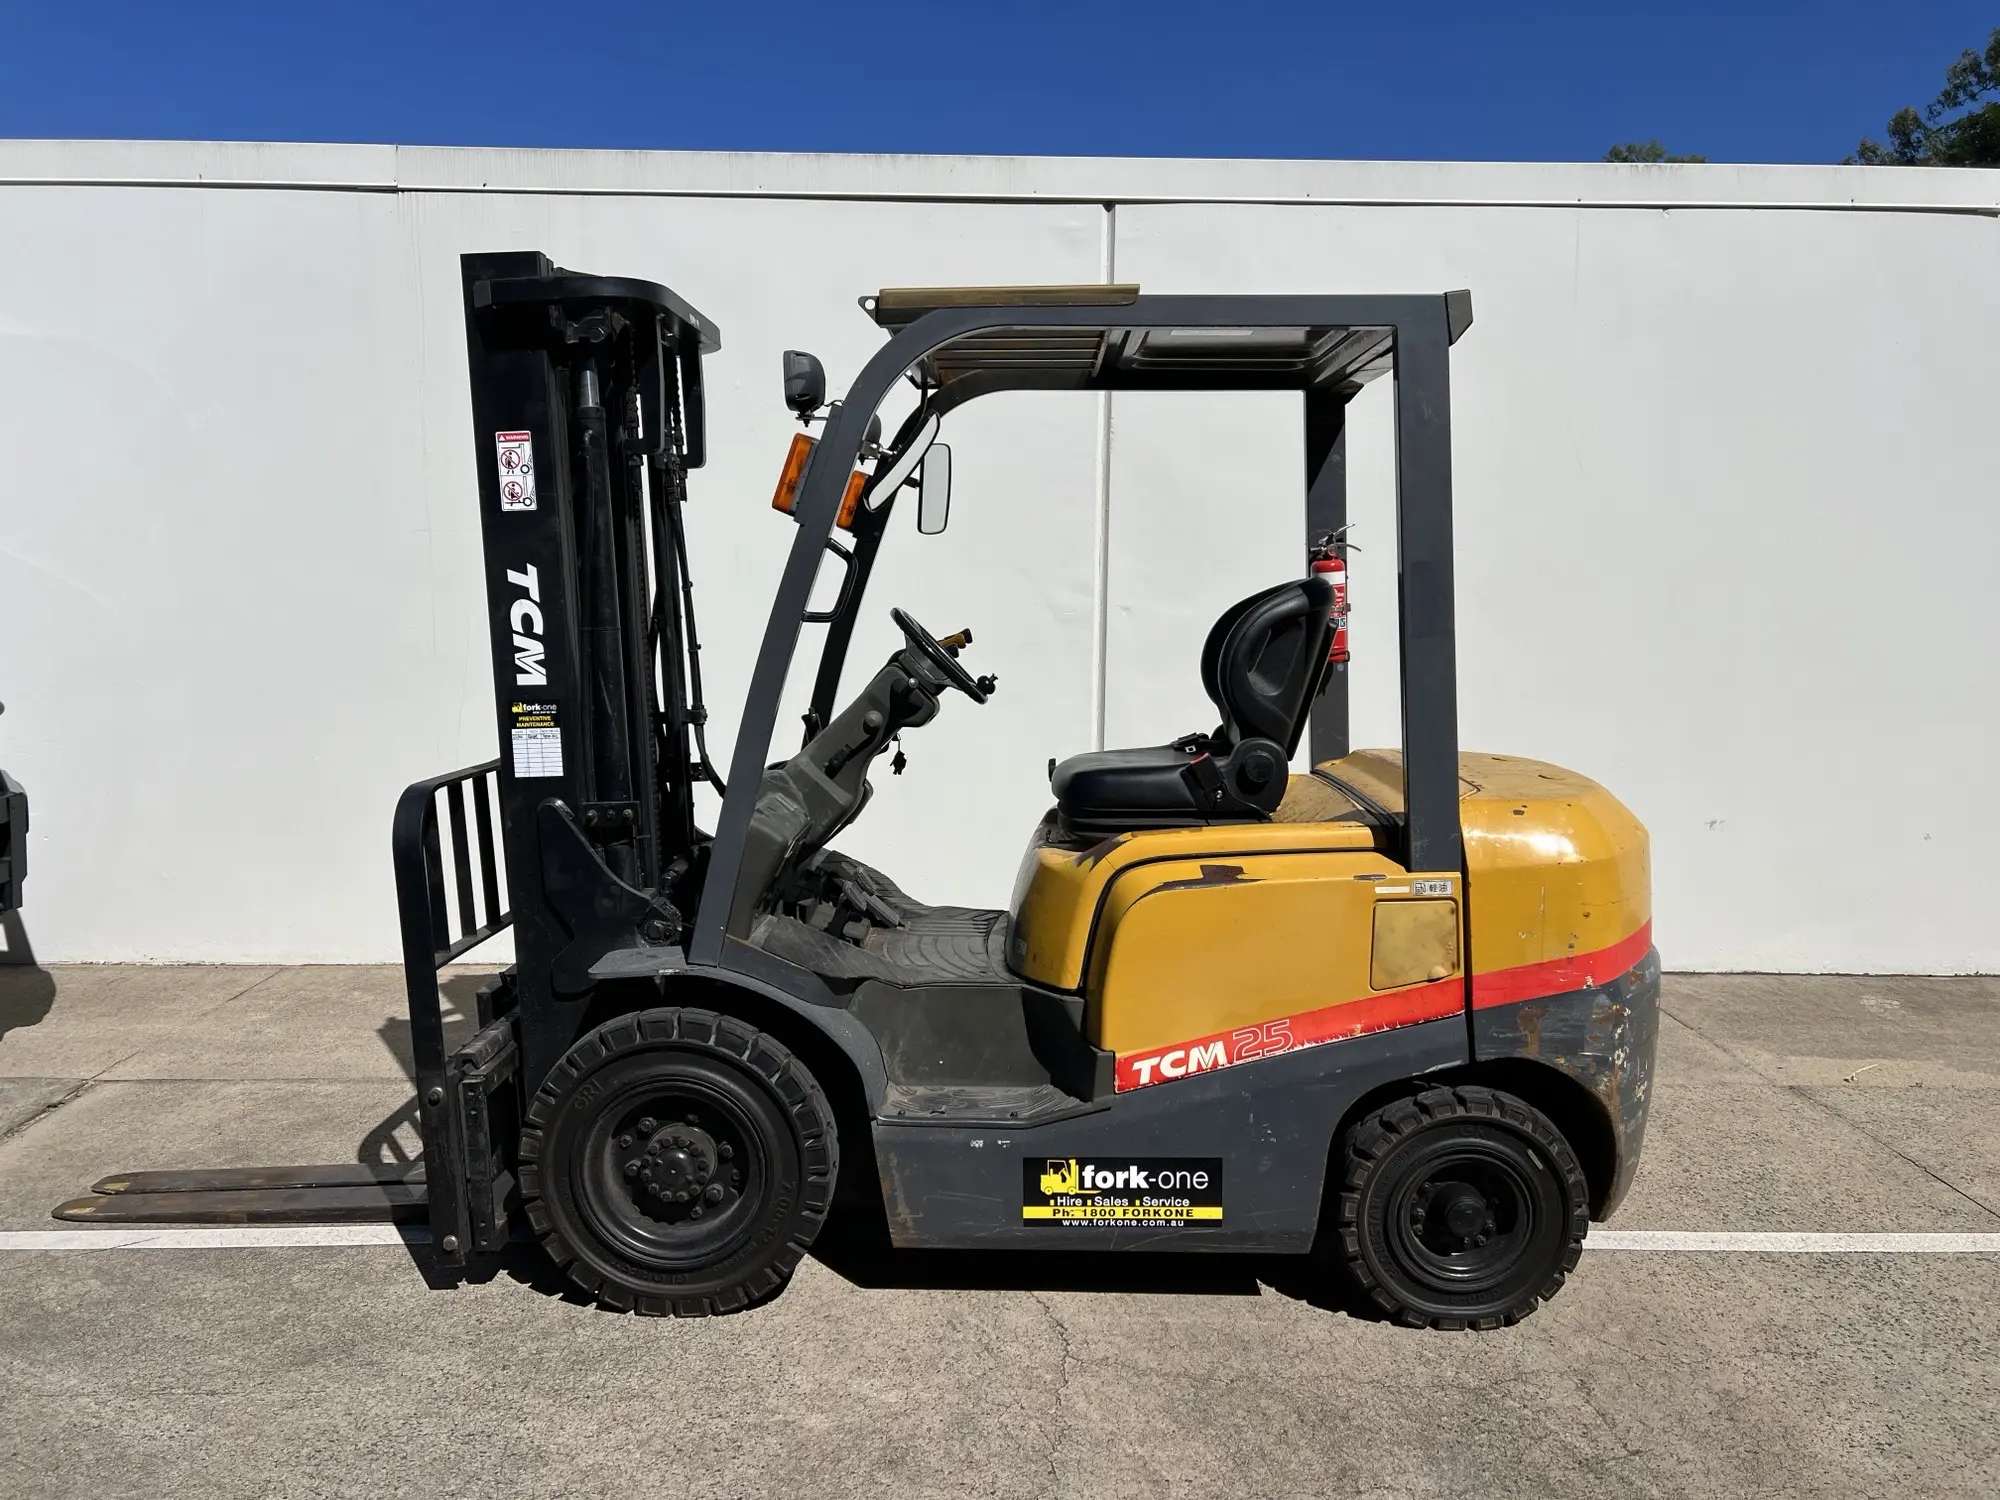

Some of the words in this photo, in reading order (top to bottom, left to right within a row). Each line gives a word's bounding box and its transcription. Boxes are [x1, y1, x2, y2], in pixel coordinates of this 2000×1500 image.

[506, 563, 547, 685] TCM
[523, 703, 557, 711] fork-one
[1132, 1040, 1228, 1085] TCM
[1232, 1018, 1294, 1064] 25
[1081, 1165, 1209, 1190] fork-one
[1057, 1196, 1083, 1207] Hire
[1094, 1196, 1129, 1207] Sales
[1142, 1196, 1190, 1207] Service
[1081, 1208, 1116, 1218] 1800
[1122, 1208, 1194, 1218] FORKONE
[1062, 1219, 1185, 1227] www.forkone.com.au
